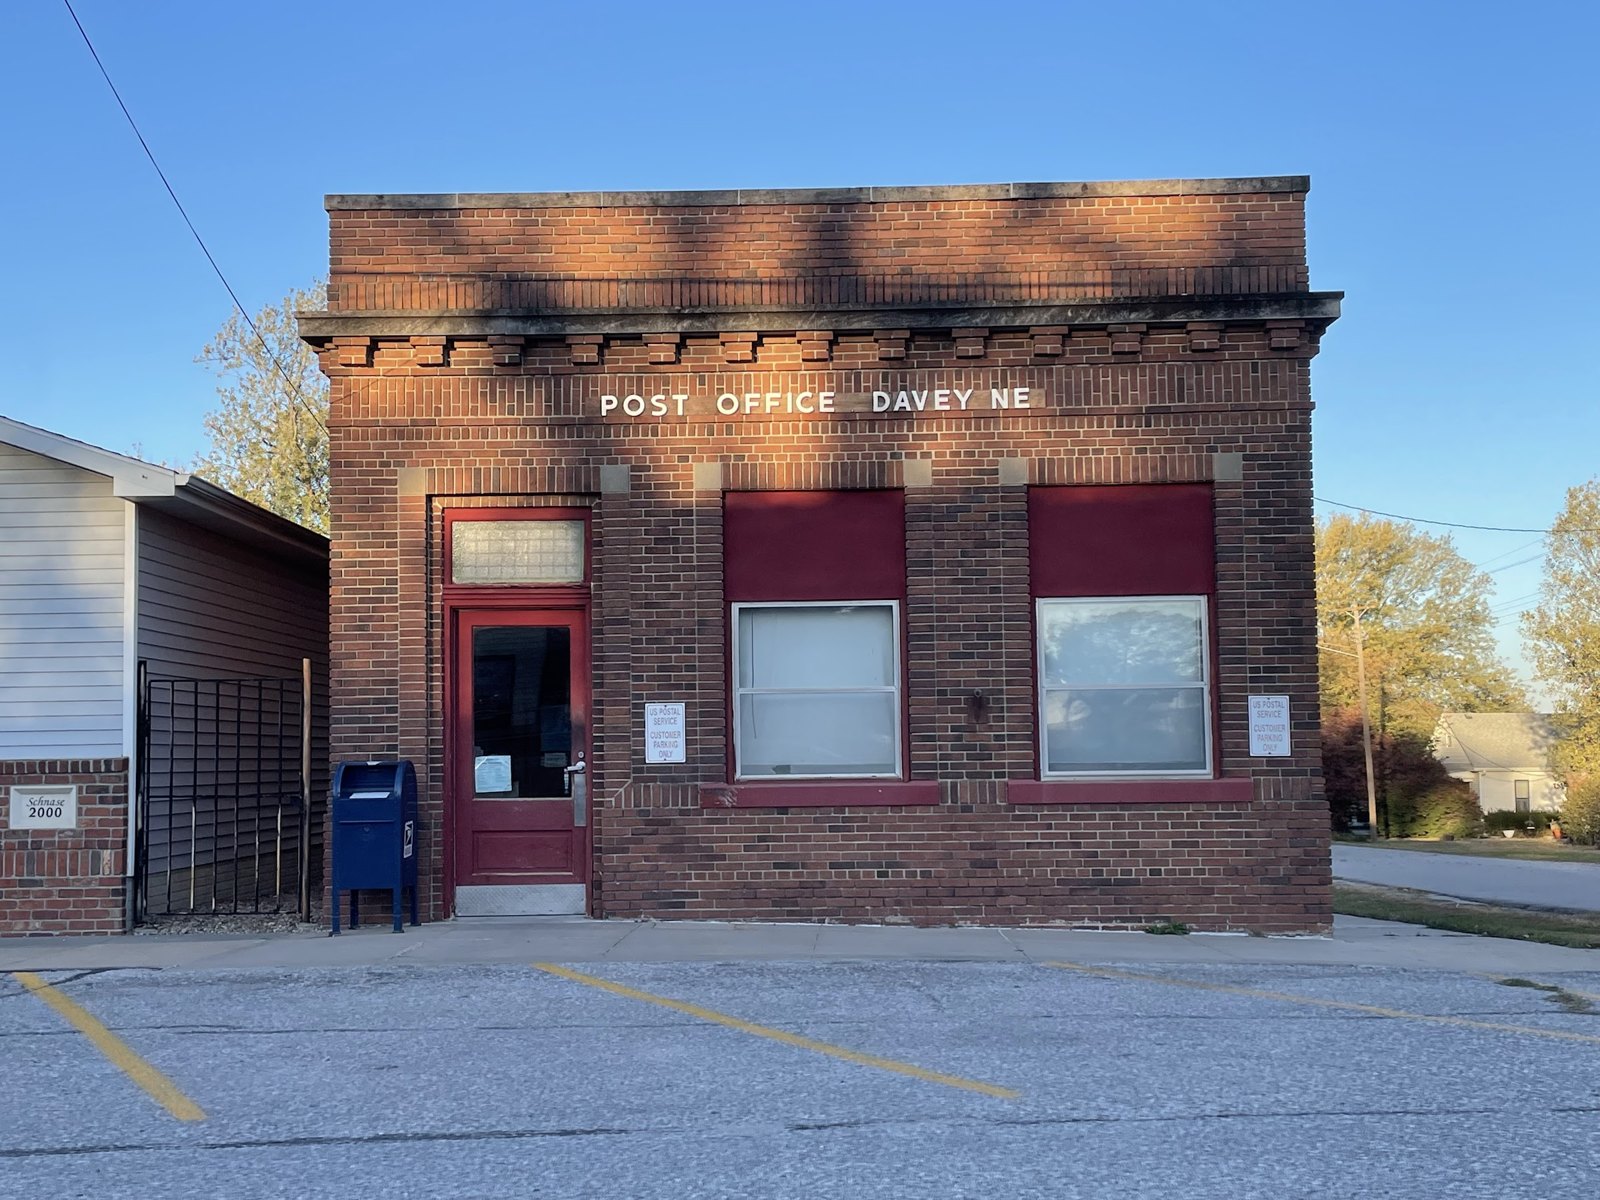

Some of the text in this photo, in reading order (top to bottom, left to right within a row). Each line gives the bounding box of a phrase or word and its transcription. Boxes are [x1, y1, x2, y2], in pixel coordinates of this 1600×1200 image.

[601, 387, 1030, 417] POST OFFICE DAVEY NE
[1253, 700, 1285, 709] US POSTAL
[650, 707, 681, 716] US POSTAL
[1257, 710, 1282, 719] SERVICE
[653, 717, 678, 726] SERVICE
[1254, 724, 1286, 733] CUSTOMER
[650, 731, 681, 739] CUSTOMER
[1257, 734, 1283, 742] PARKING
[653, 740, 679, 749] PARKING
[1263, 743, 1277, 752] ONLY
[659, 750, 673, 758] ONLY
[26, 796, 65, 807] Schnase
[28, 807, 62, 818] 2000
